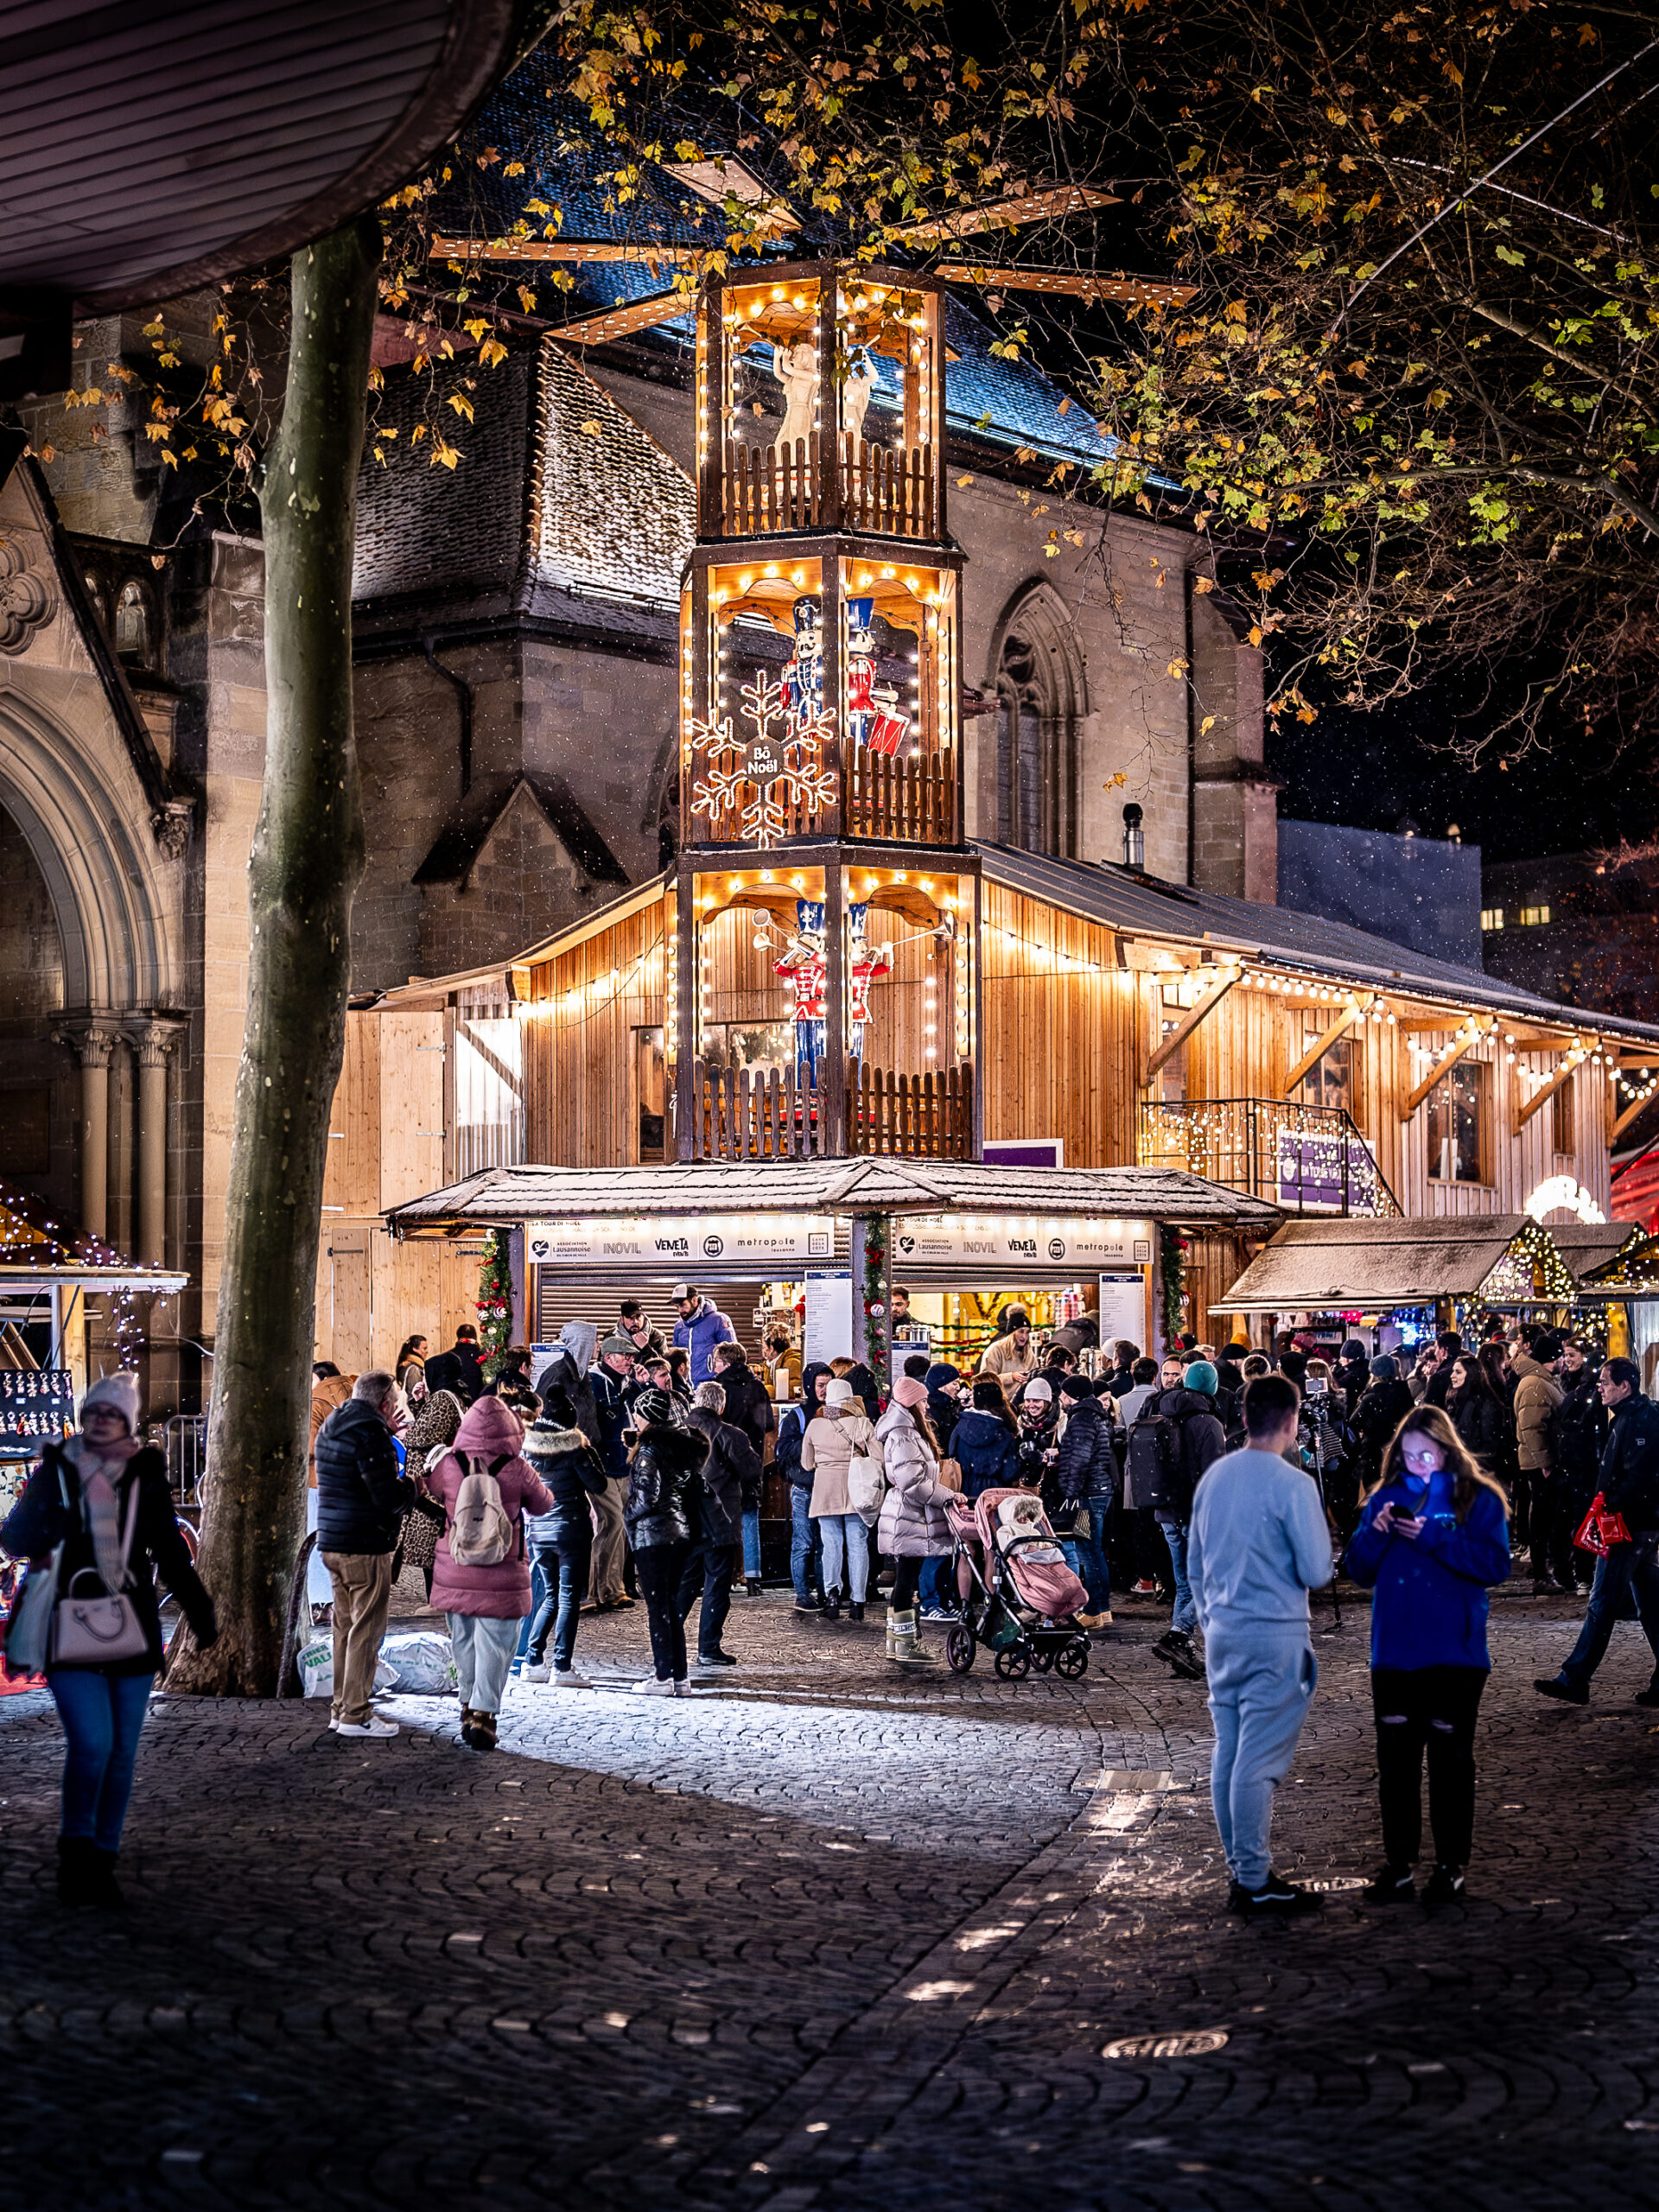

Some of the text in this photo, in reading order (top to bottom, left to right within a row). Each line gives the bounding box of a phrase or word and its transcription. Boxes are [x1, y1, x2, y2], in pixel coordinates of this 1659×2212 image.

[753, 746, 771, 760] Bô
[747, 760, 778, 775] Noël
[603, 1242, 641, 1255] INOVIL
[654, 1237, 689, 1250] VENETA
[737, 1237, 795, 1247] metropole
[963, 1241, 997, 1254] INOVIL
[1007, 1238, 1037, 1251] VENETA
[1077, 1243, 1123, 1252] metropole
